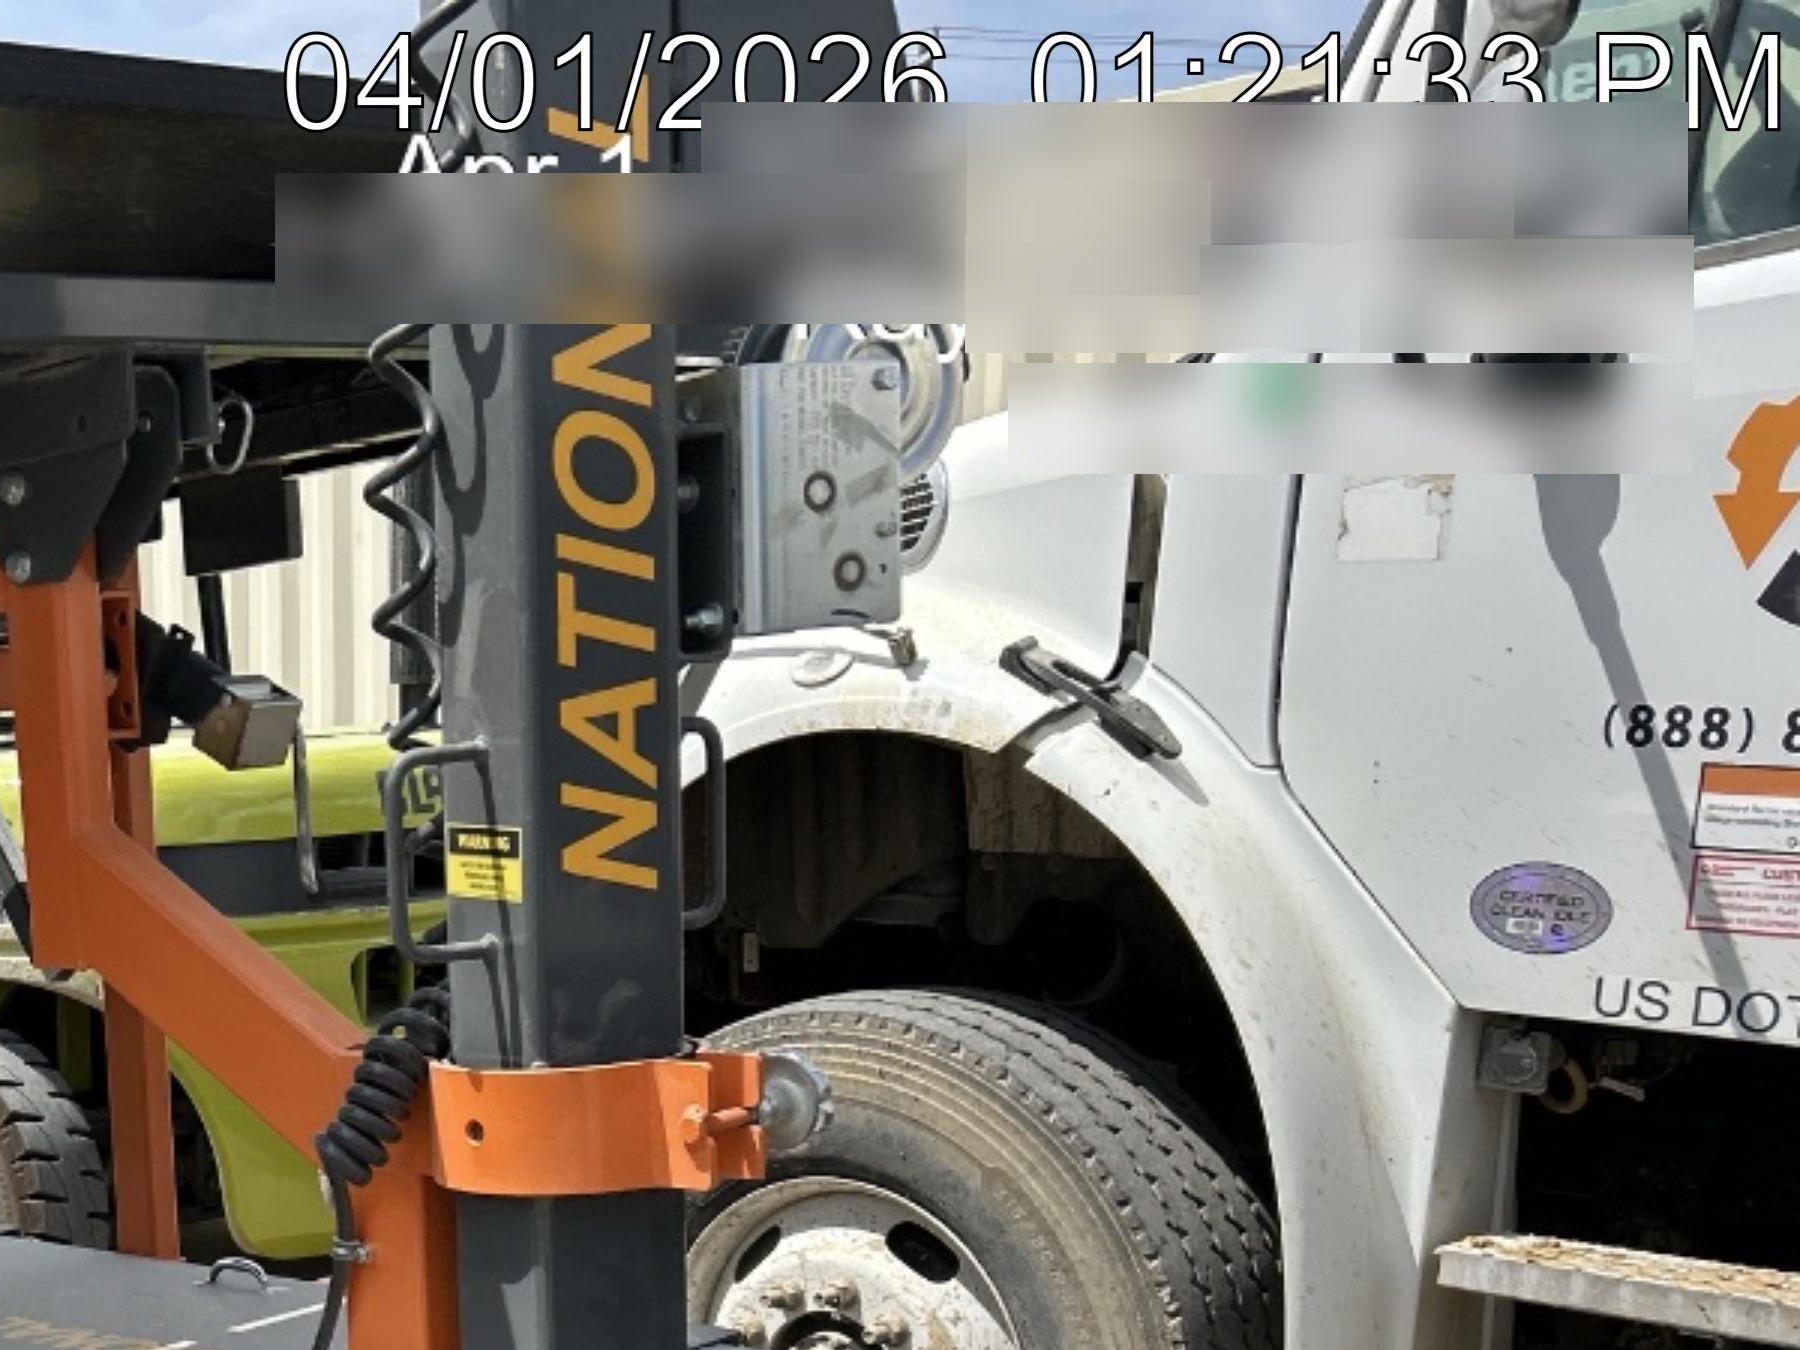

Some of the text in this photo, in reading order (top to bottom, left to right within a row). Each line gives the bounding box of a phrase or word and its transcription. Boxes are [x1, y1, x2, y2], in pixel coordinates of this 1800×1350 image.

[547, 72, 659, 892] NATIONL
[1603, 703, 1754, 754] (888)
[1594, 976, 1670, 1022] US
